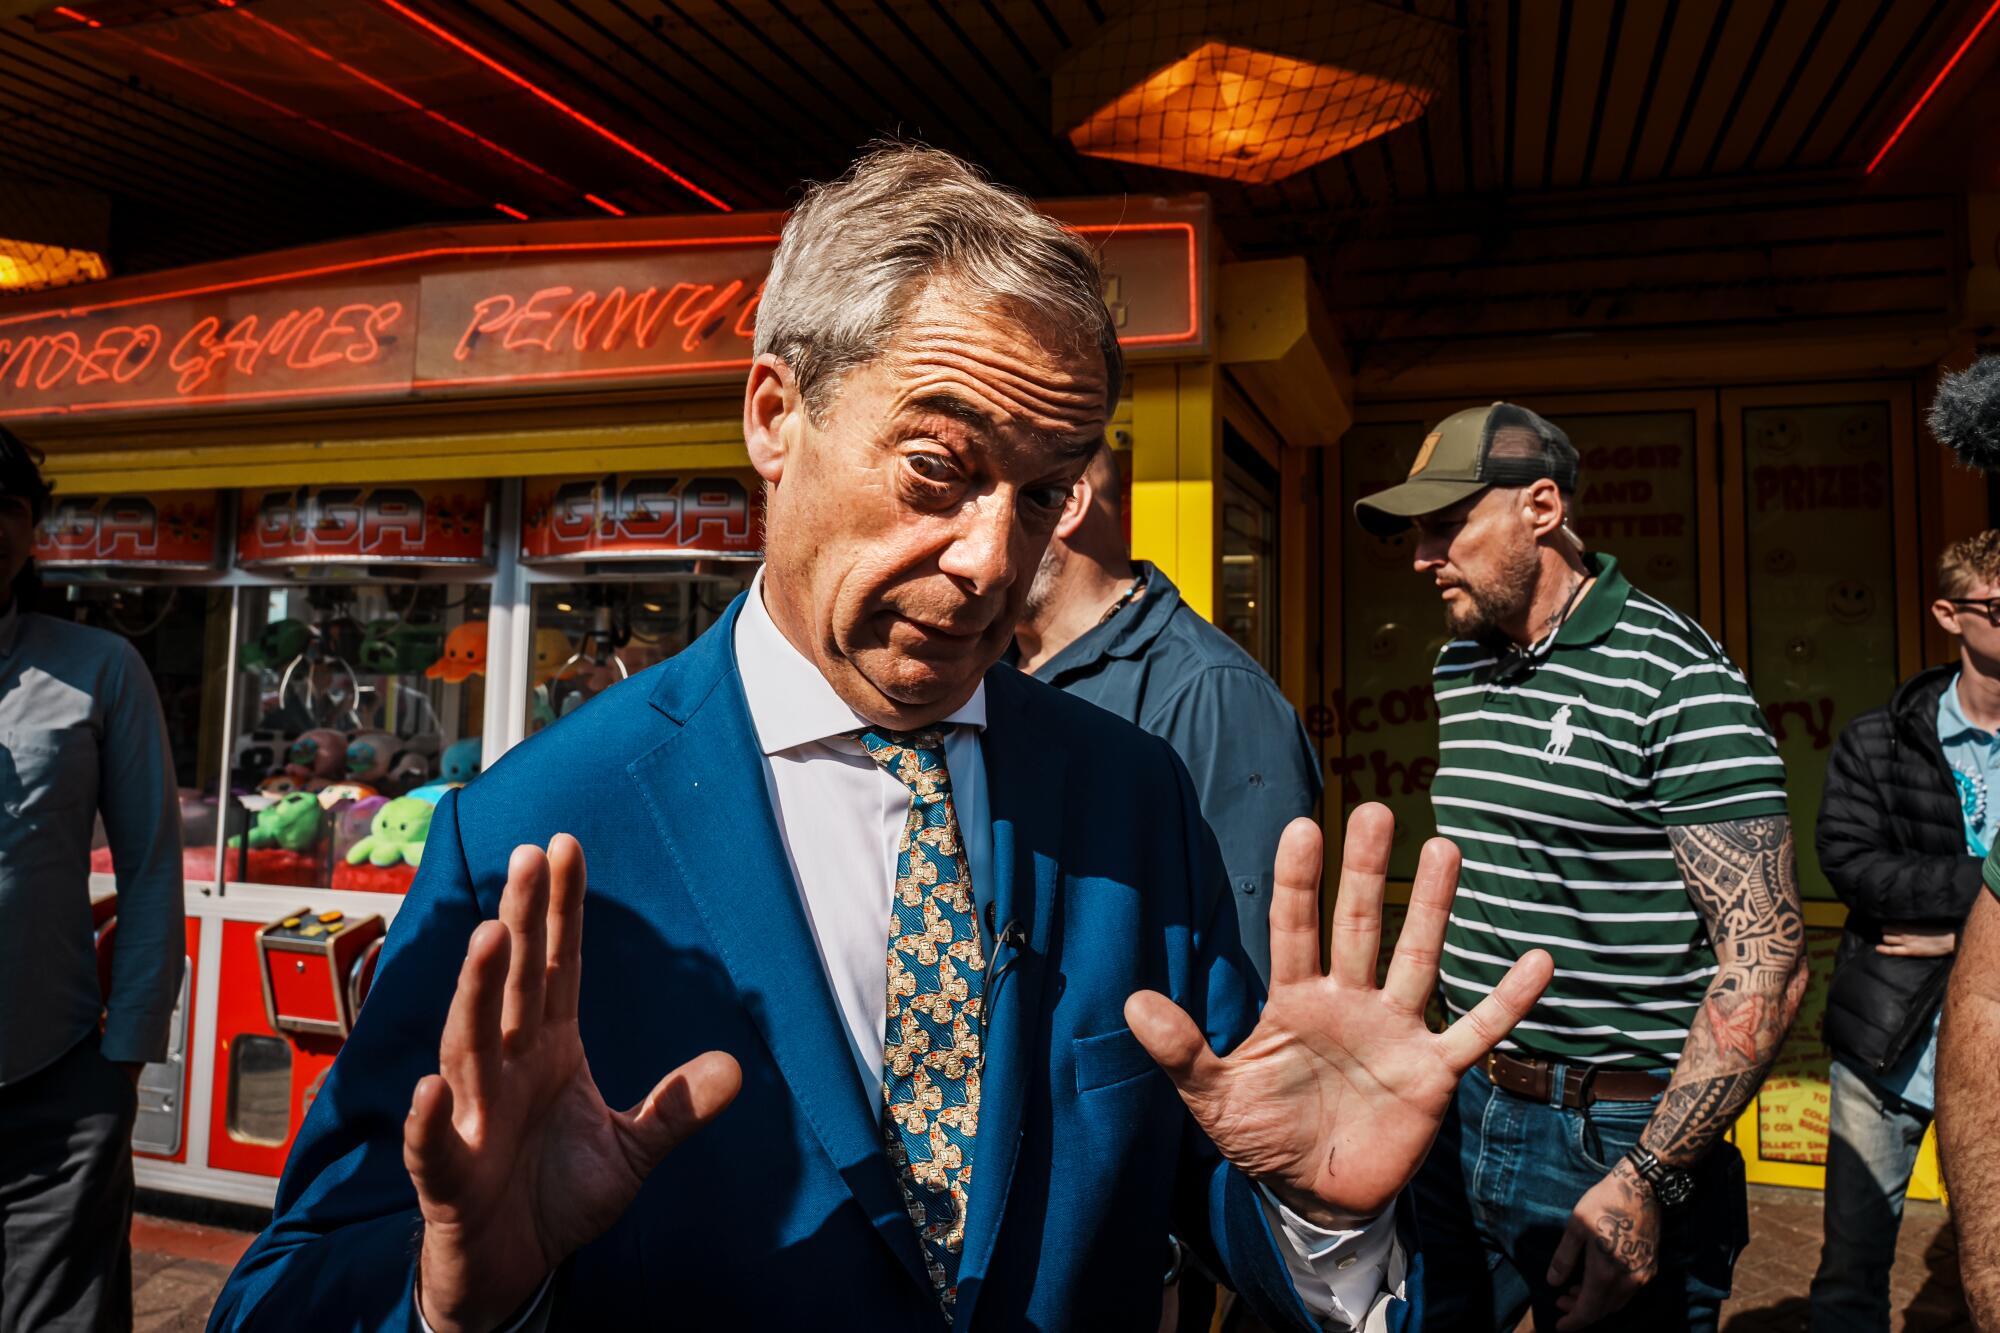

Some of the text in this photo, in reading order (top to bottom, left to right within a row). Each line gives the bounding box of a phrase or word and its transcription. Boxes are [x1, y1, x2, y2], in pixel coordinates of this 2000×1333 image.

[168, 300, 402, 394] GAMES
[453, 279, 744, 361] PENNY
[552, 473, 750, 546] GIGA
[1583, 480, 1653, 504] AND
[1330, 750, 1439, 803] The
